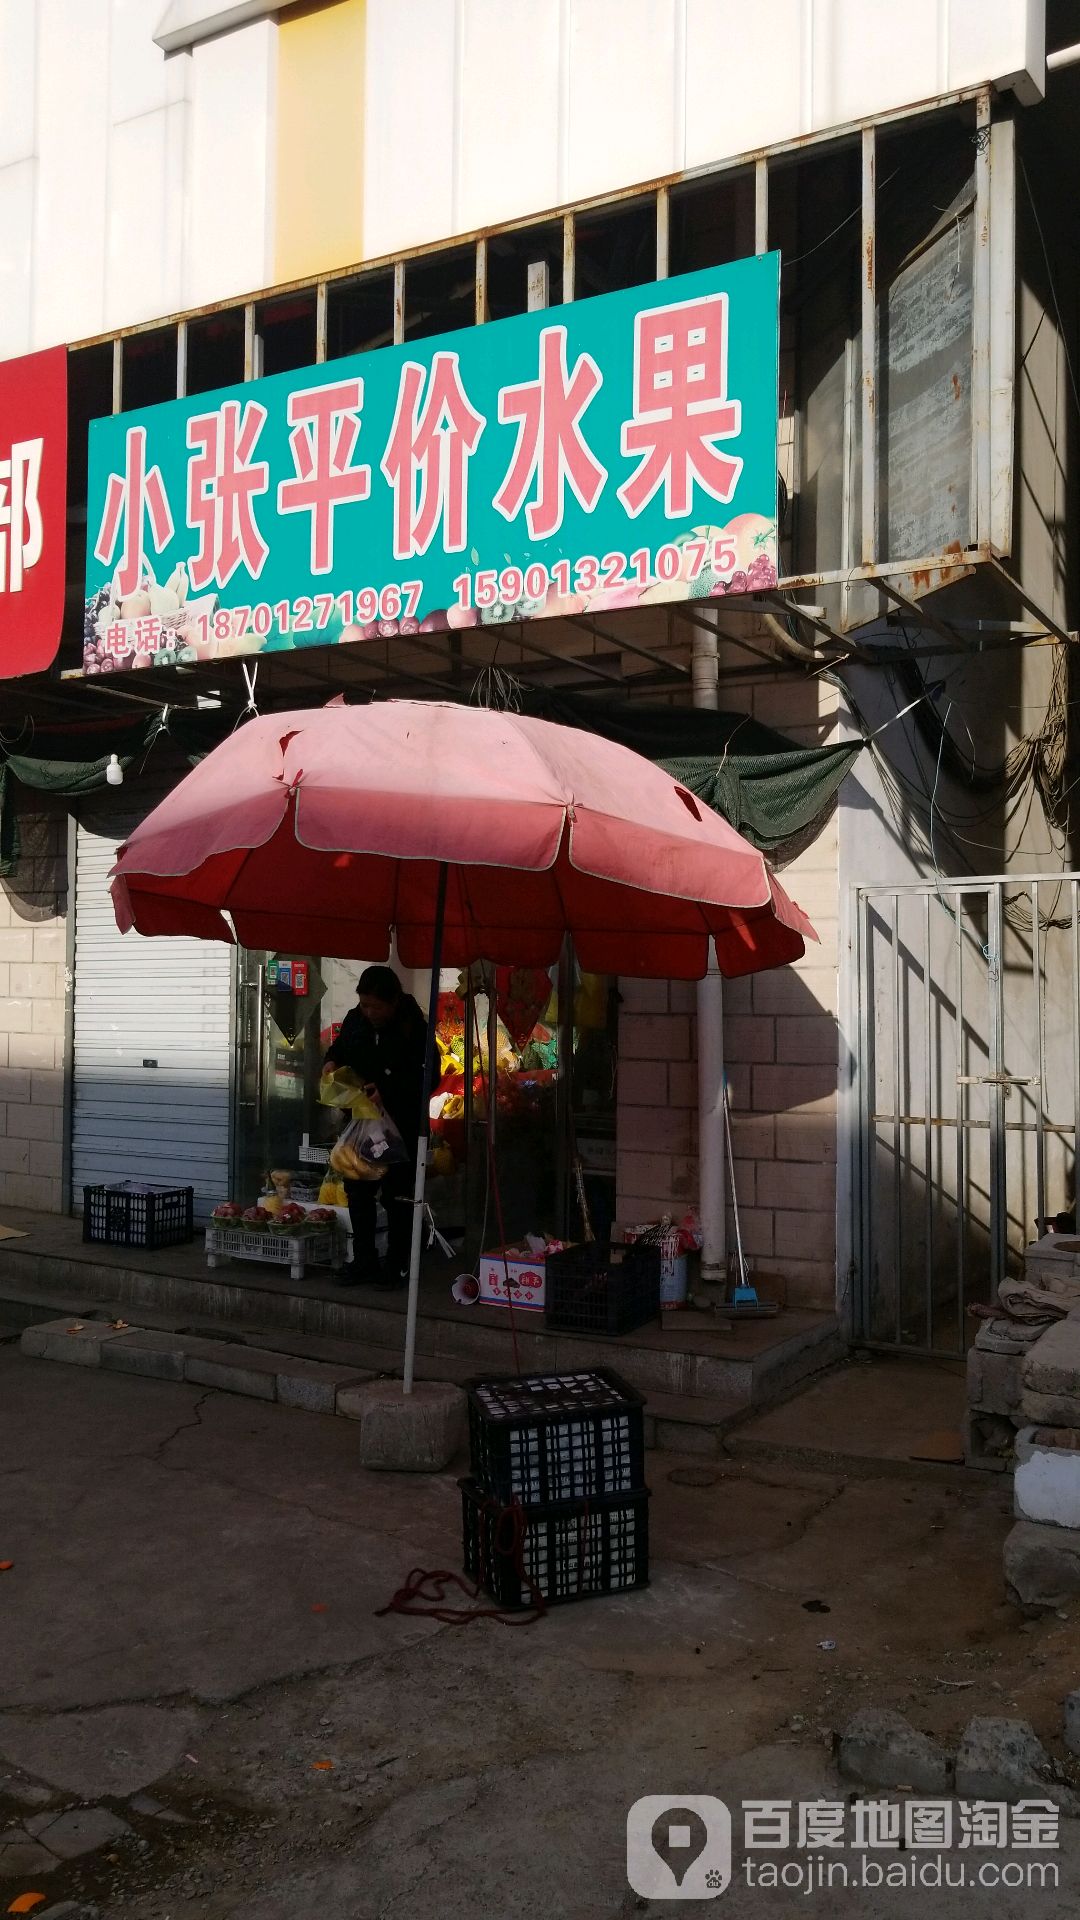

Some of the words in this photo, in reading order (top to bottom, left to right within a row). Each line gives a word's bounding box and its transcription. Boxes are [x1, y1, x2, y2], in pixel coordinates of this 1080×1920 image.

[95, 292, 743, 598] 小张平价水果
[196, 581, 423, 644] 18701271967
[453, 535, 737, 610] 15901321075
